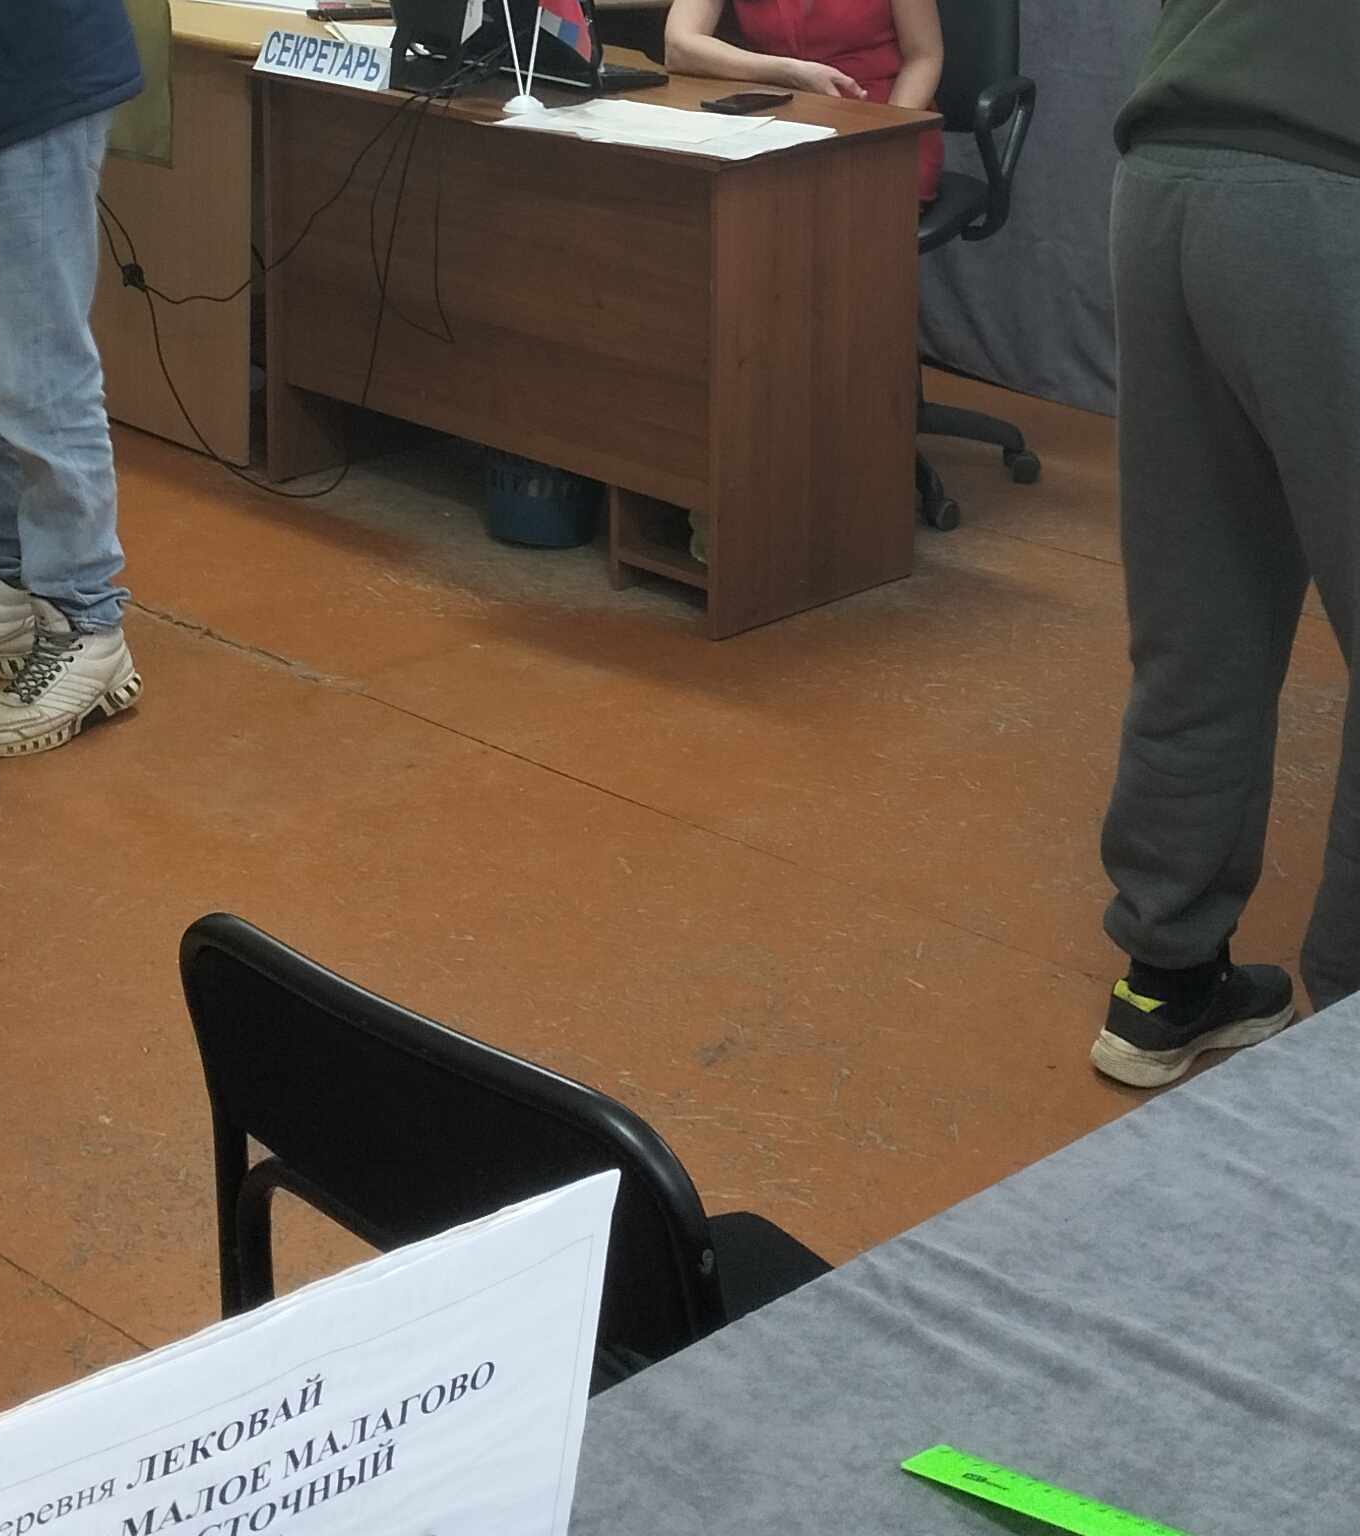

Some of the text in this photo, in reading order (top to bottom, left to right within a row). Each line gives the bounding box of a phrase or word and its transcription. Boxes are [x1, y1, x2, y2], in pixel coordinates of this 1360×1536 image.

[264, 30, 381, 82] СЕКРЕТАРЬ
[121, 1361, 495, 1536] МАЛОЕ МАЛАГОВО
[126, 1373, 325, 1491] ЛЕКОВАЙ
